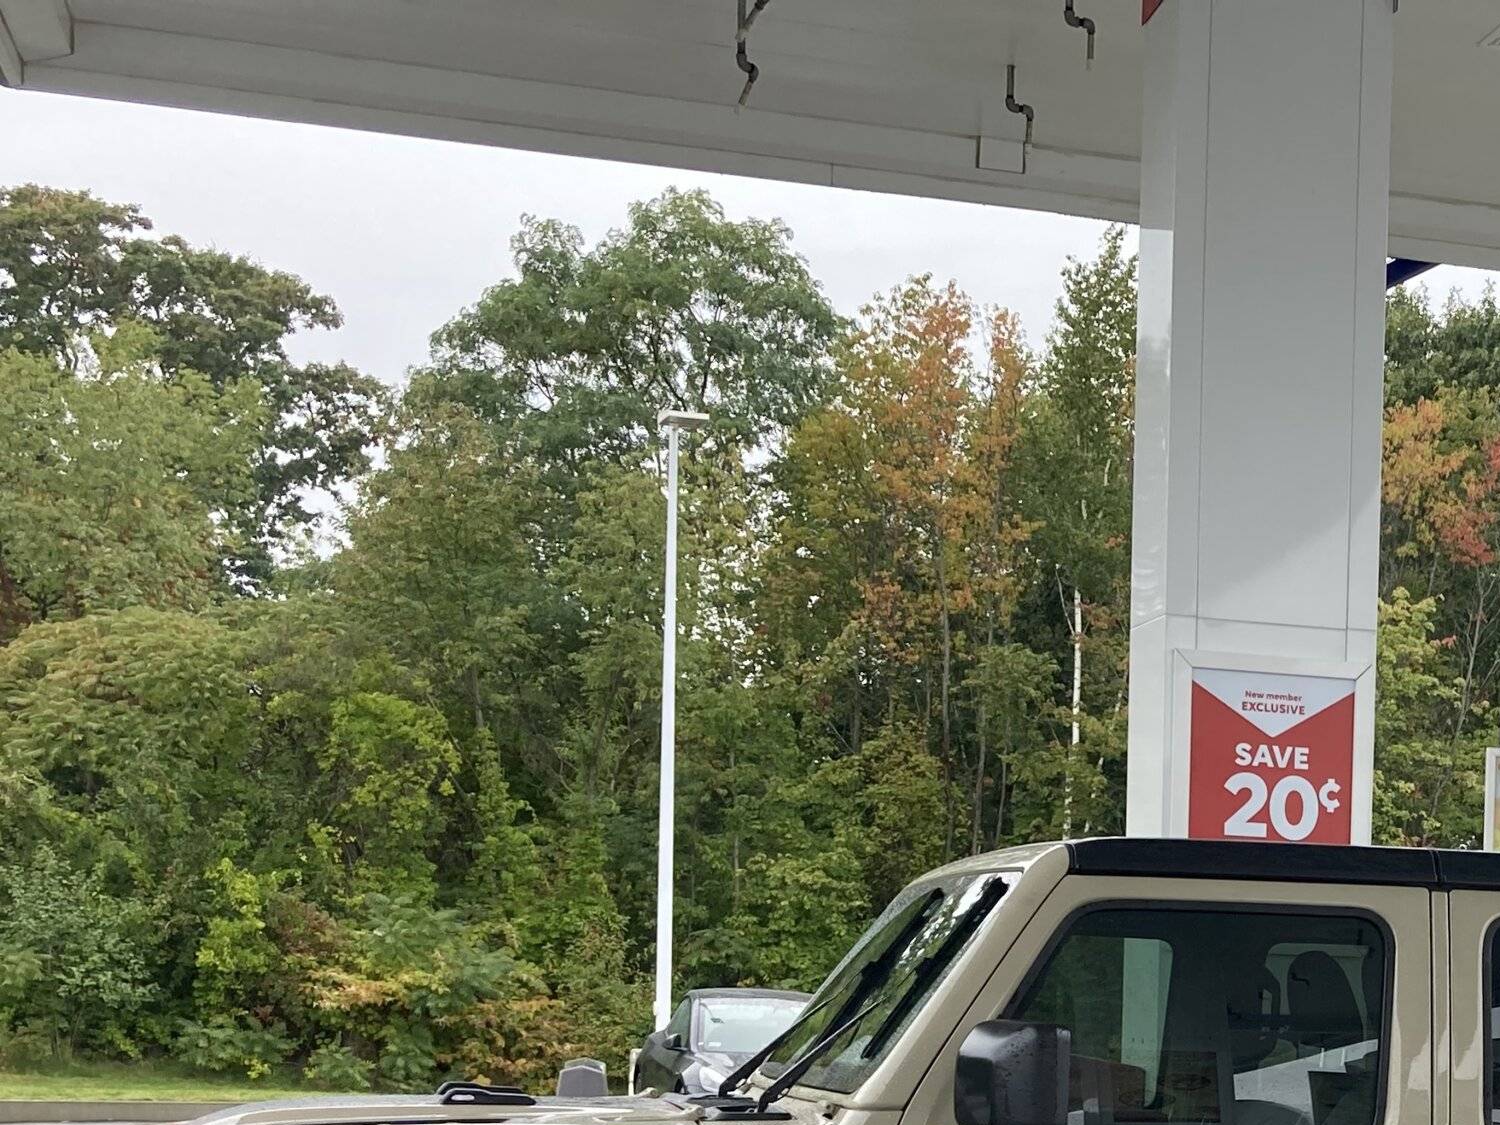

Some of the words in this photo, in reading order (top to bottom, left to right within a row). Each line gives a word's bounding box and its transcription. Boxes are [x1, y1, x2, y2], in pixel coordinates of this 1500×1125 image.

[1245, 690, 1264, 698] New
[1266, 693, 1302, 702] member
[1242, 702, 1306, 715] EXCLUSIVE
[1235, 742, 1310, 770] SAVE
[1223, 772, 1342, 841] 20¢
